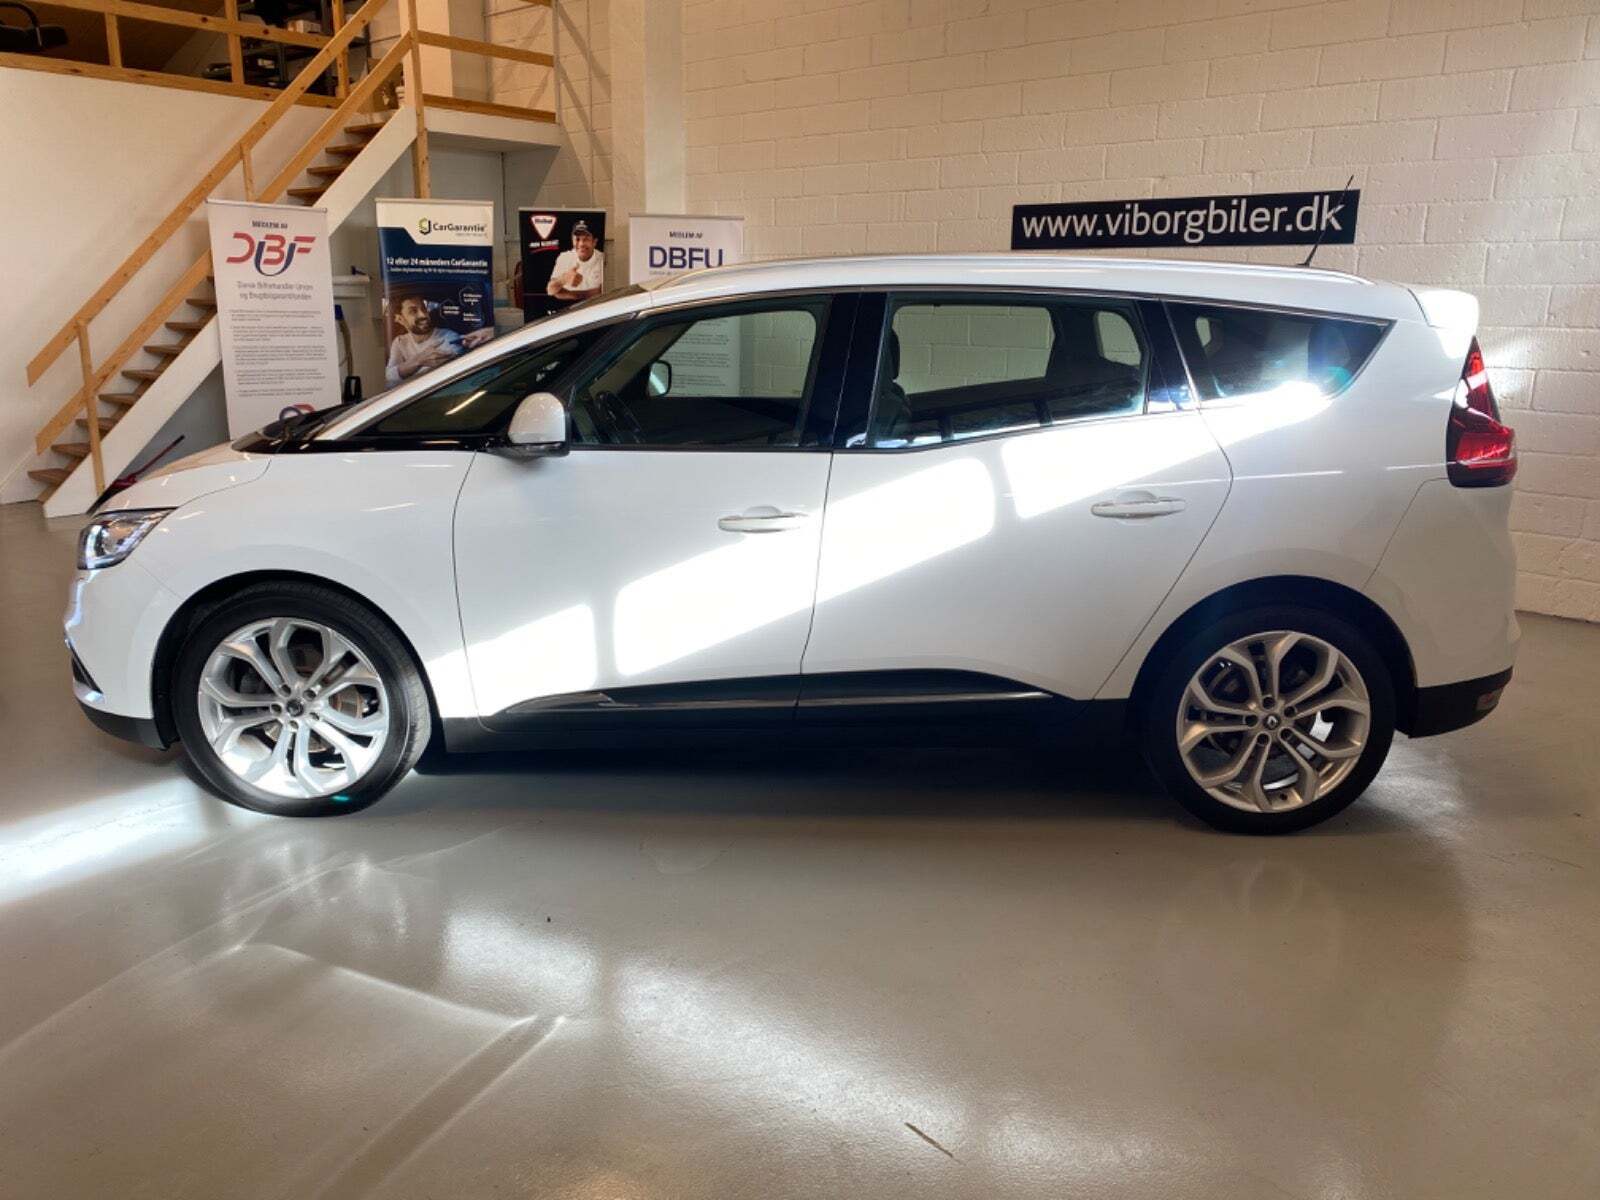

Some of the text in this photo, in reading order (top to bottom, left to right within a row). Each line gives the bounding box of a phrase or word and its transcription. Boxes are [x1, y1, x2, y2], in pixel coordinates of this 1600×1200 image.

[432, 222, 485, 232] CarGarantie
[1021, 194, 1345, 244] www.viborgbiler.dk
[648, 245, 723, 269] DBFU
